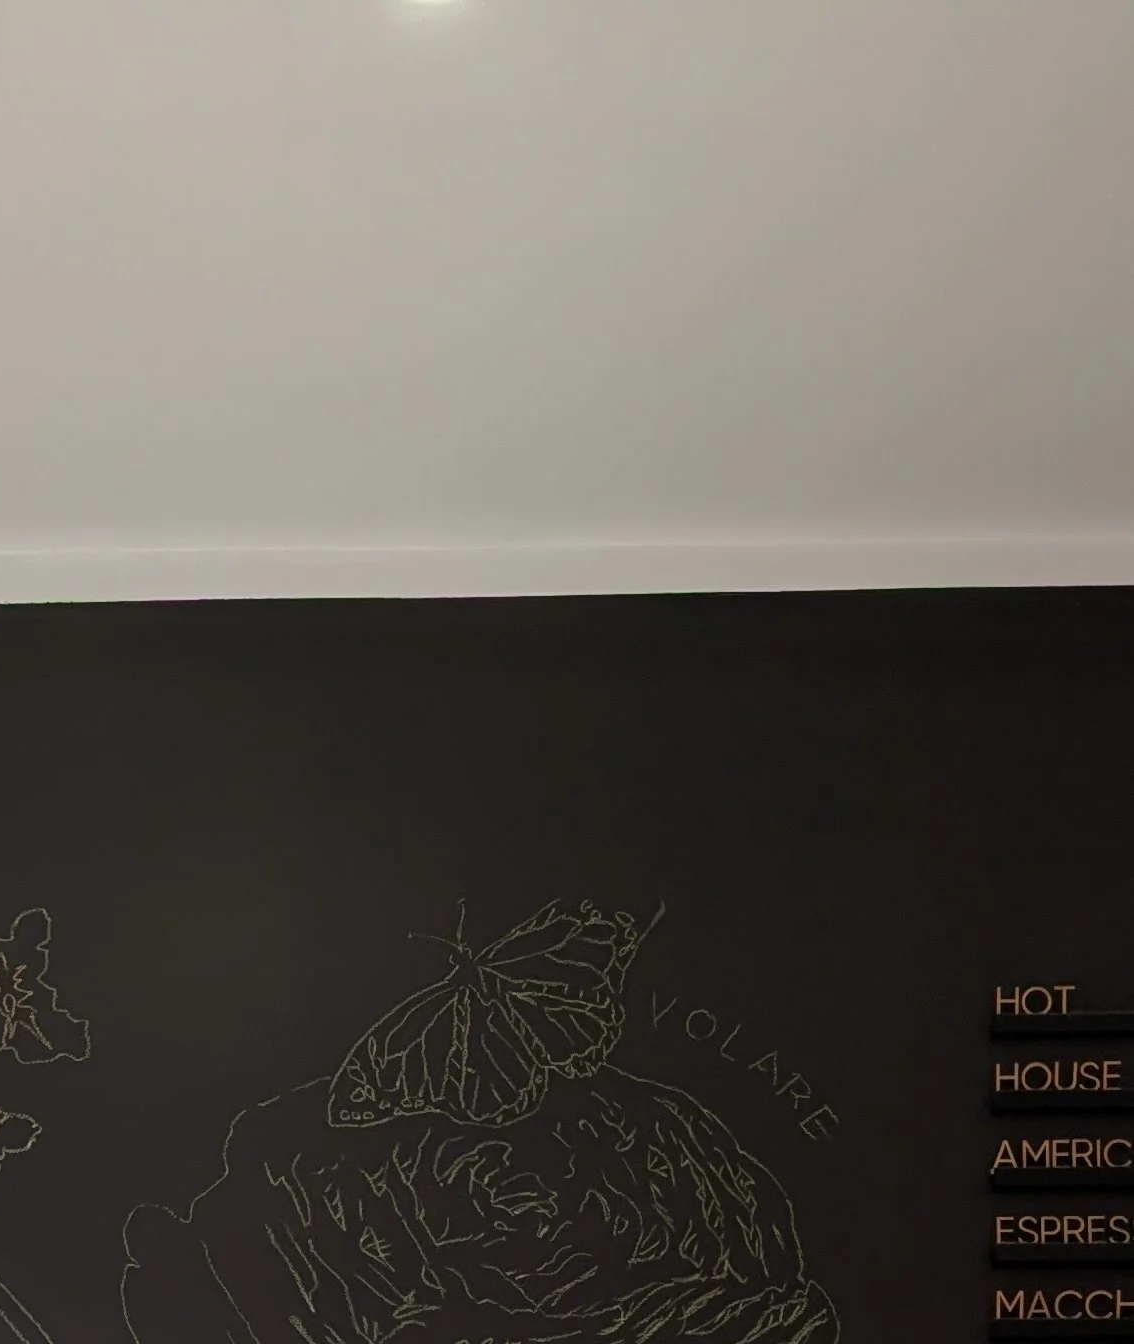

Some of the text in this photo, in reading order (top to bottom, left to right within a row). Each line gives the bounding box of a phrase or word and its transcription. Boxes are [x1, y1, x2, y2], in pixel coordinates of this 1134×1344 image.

[997, 985, 1075, 1015] HOT
[653, 991, 839, 1140] VOLARE
[996, 1060, 1122, 1091] HOUSE
[993, 1138, 1132, 1168] AMERIC
[996, 1215, 1134, 1245] ESPRES
